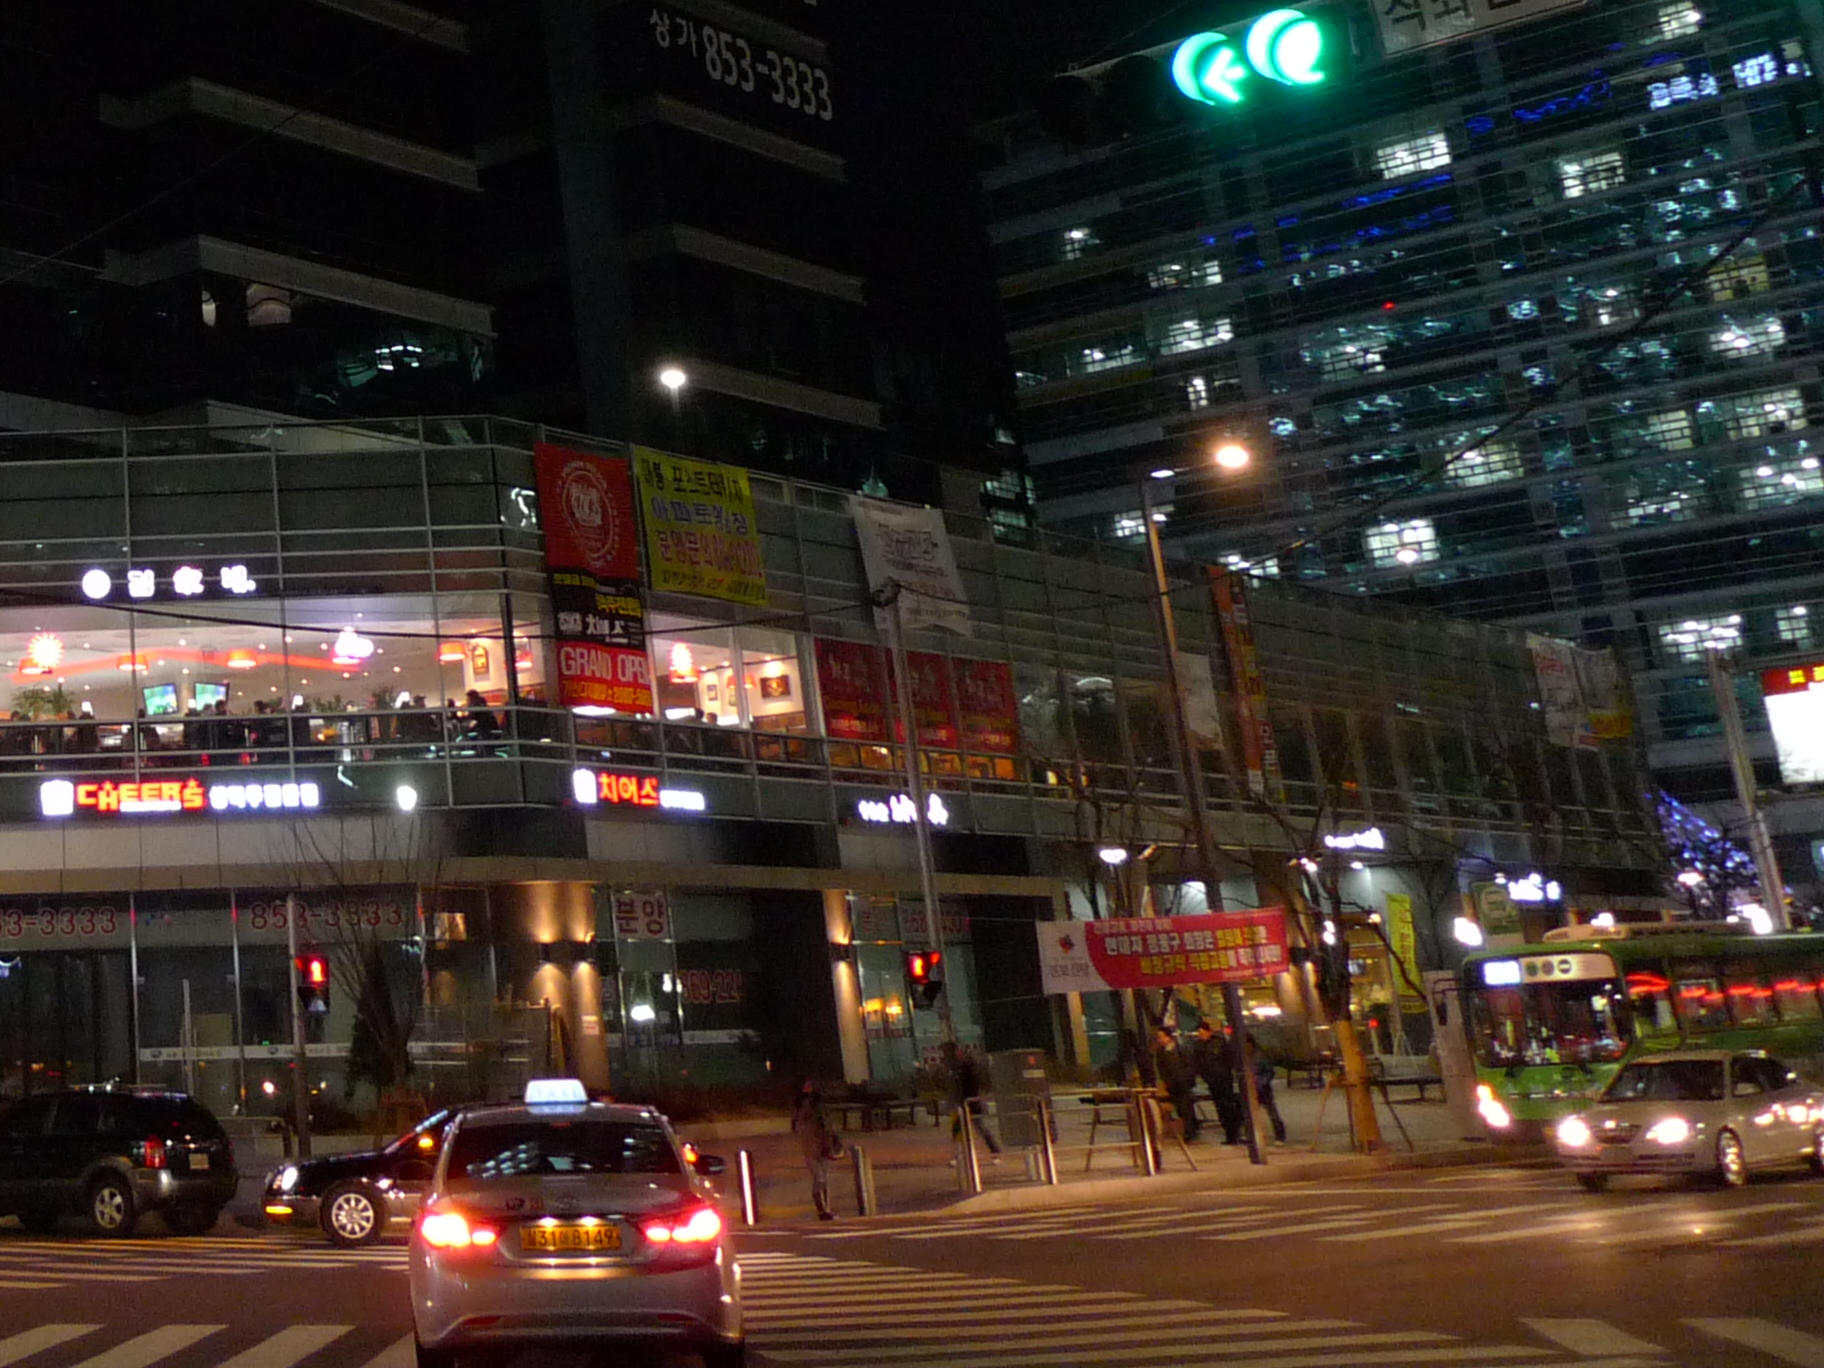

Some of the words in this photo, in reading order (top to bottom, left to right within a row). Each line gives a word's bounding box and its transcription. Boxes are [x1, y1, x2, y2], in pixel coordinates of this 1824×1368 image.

[702, 25, 834, 122] 853-3333
[76, 779, 207, 811] CHEERS
[615, 898, 667, 937] 분양
